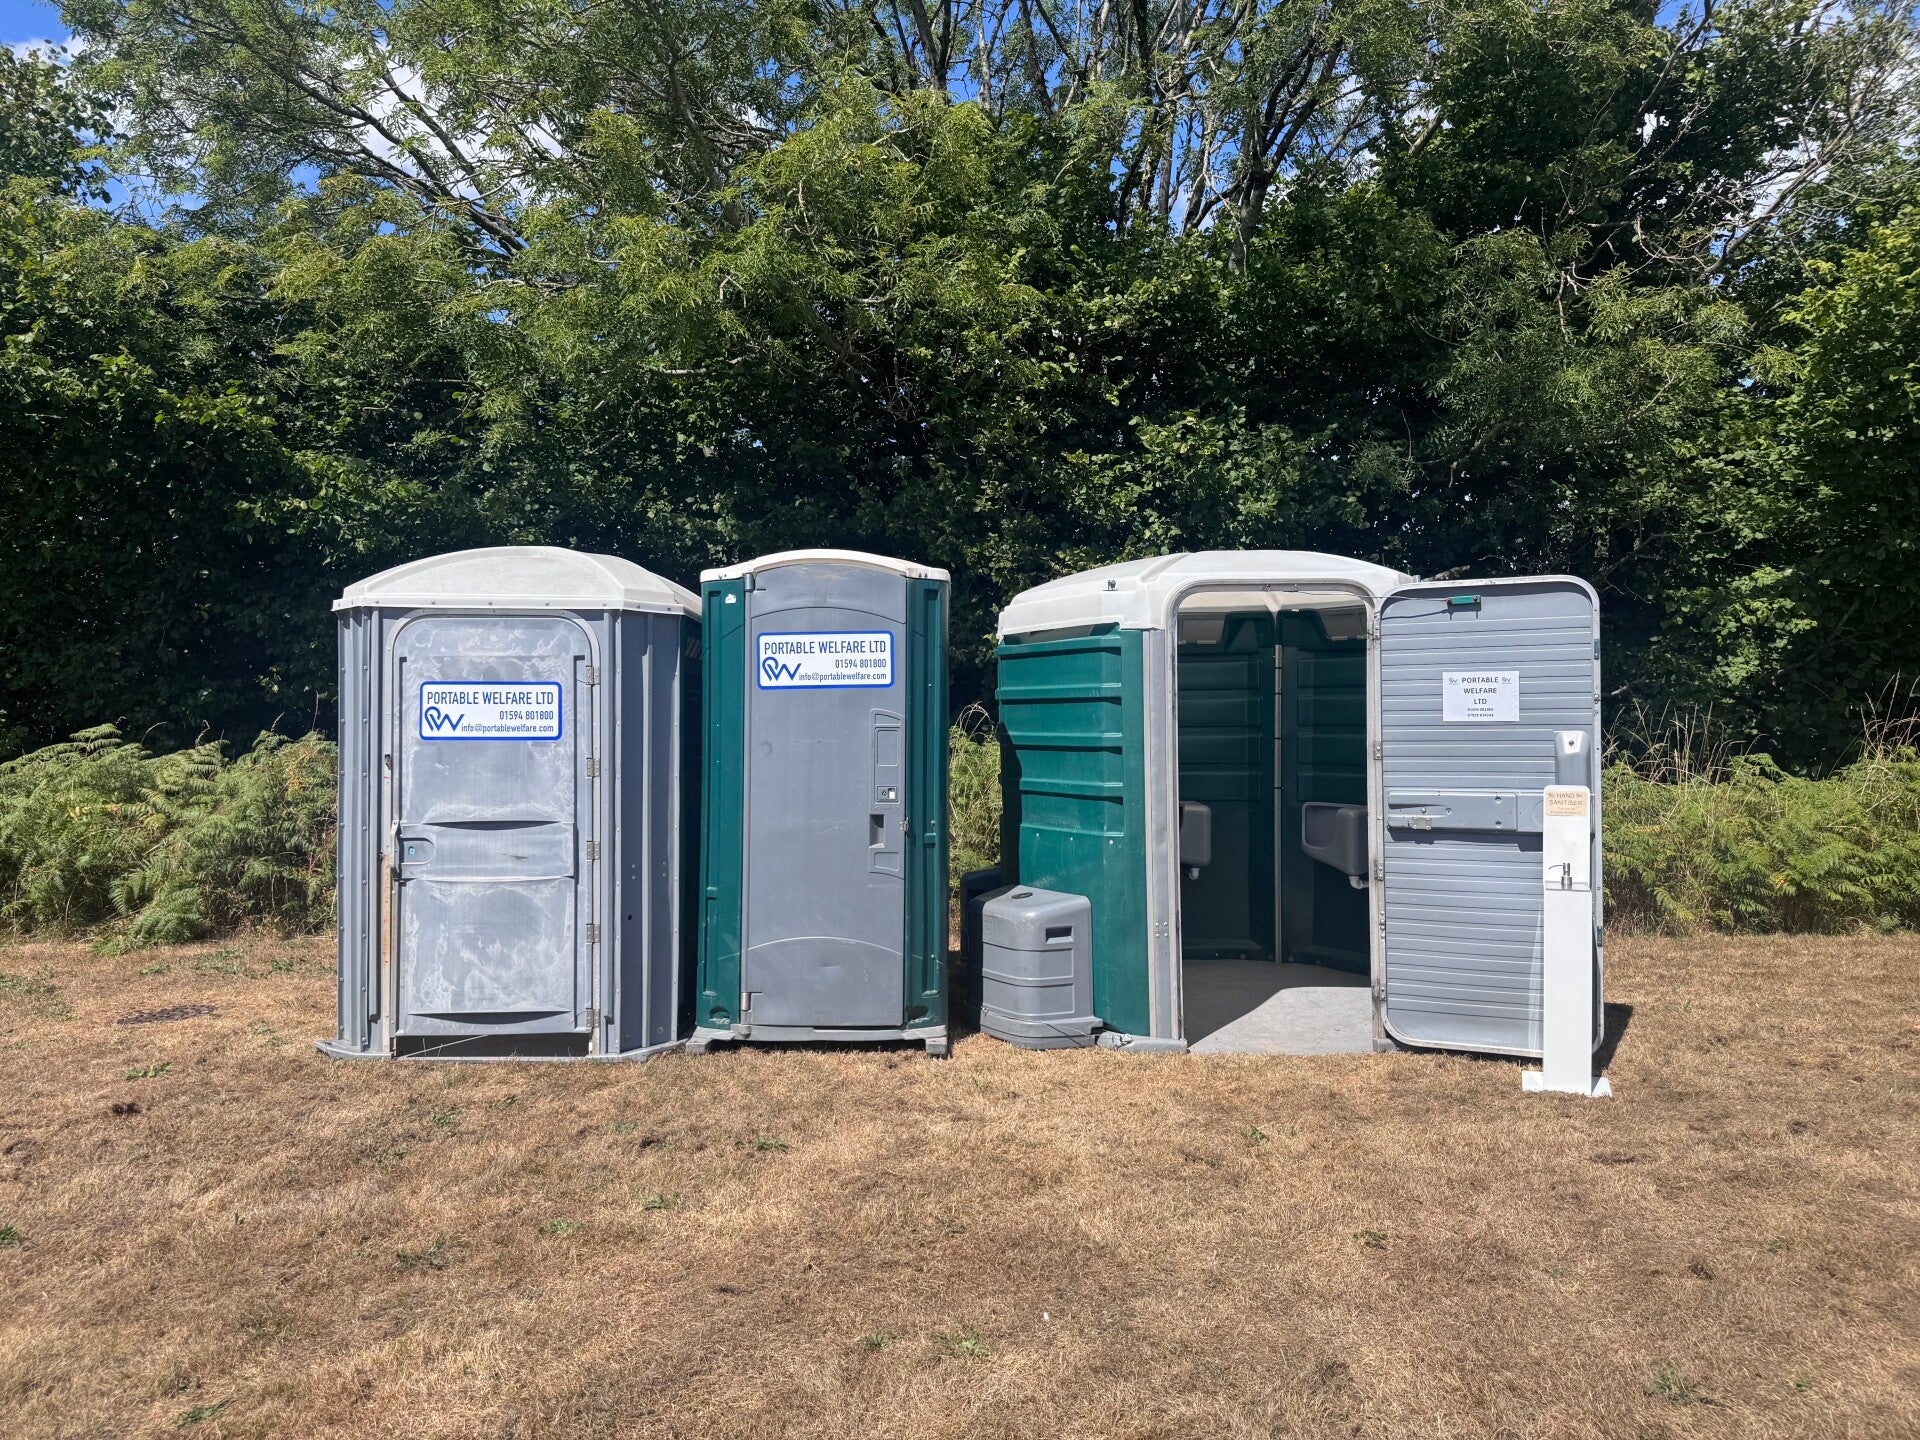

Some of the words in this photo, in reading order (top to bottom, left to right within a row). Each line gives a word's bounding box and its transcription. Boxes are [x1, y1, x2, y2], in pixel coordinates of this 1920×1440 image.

[764, 641, 816, 655] PORTABLE
[818, 641, 866, 654] WELFARE
[869, 640, 887, 653] LTD
[835, 659, 858, 669] 01594
[860, 658, 887, 668] 801800
[798, 672, 887, 683] info@portablewelfare.com
[427, 692, 479, 704] PORTABLE
[482, 692, 532, 704] WELFARE
[536, 692, 554, 704] LTD
[499, 710, 523, 720] 01594
[525, 710, 554, 720] 801800
[461, 723, 554, 734] info@portablewelfare.com
